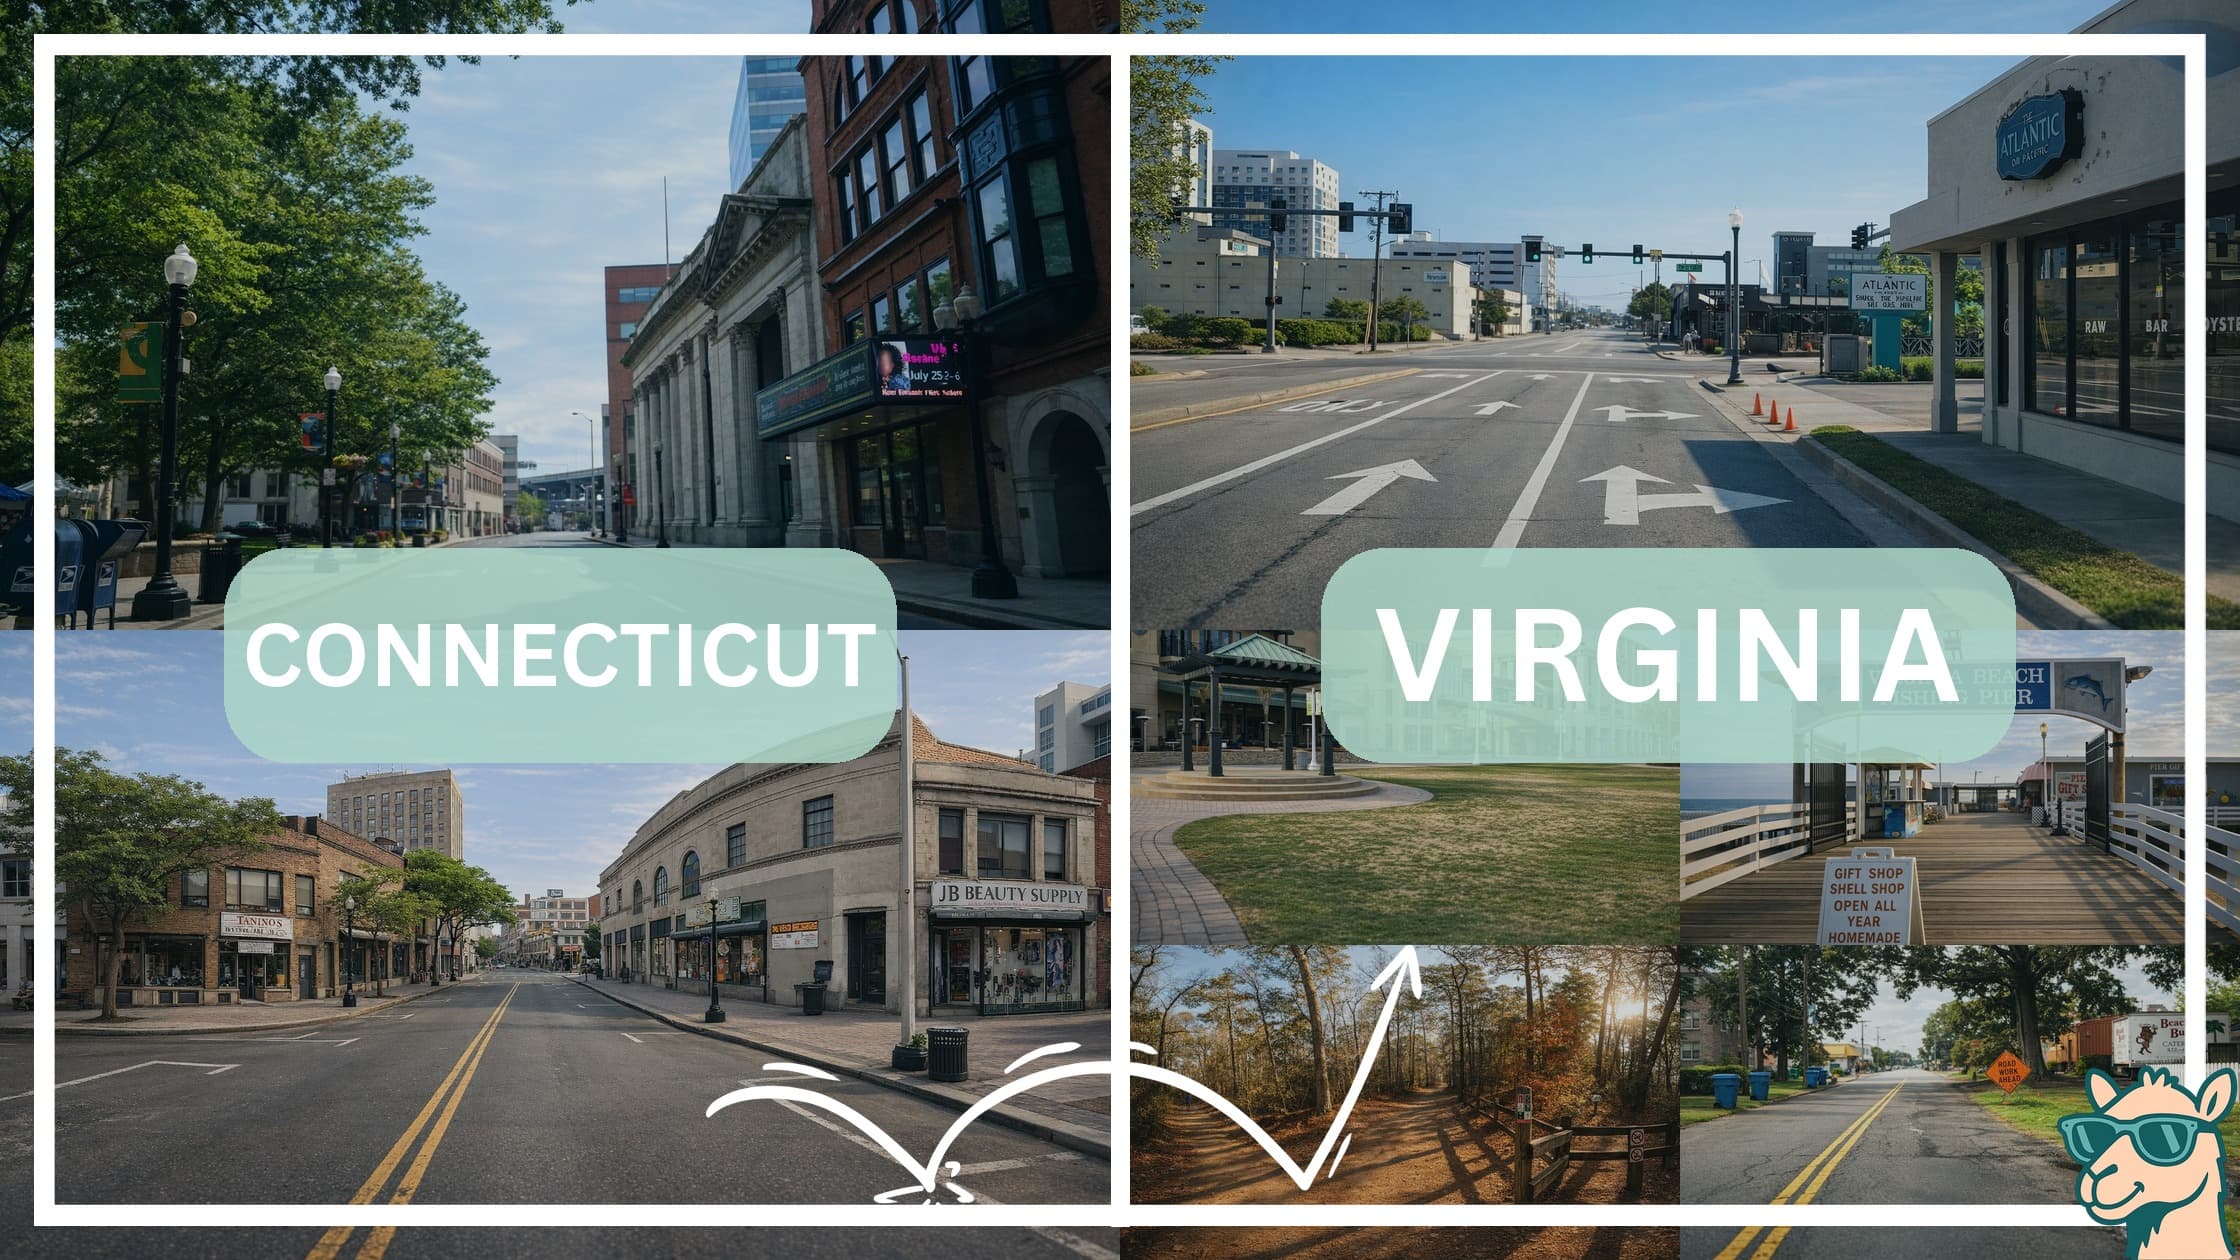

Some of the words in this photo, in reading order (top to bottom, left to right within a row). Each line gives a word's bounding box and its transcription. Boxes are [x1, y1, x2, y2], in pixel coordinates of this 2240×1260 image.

[2001, 112, 2060, 158] ATLANTIC
[1862, 280, 1916, 290] ATLANTIC
[2085, 321, 2107, 334] RAW
[2145, 319, 2168, 333] BAR
[910, 369, 929, 383] July
[1277, 398, 1401, 413] ONLY
[2058, 782, 2079, 794] GIFT
[1834, 868, 1862, 879] GIFT
[1868, 868, 1903, 879] SHOP
[939, 885, 959, 902] JB
[965, 886, 1027, 902] BEAUTY
[1031, 888, 1083, 904] SUPPLY
[1830, 883, 1867, 895] SHELL
[1871, 883, 1905, 895] SHOP
[1834, 900, 1868, 911] OPEN
[1874, 900, 1896, 911] ALL
[1847, 916, 1881, 927] YEAR
[1828, 932, 1901, 943] HOMEMADE
[1999, 1068, 2019, 1076] WORK
[1998, 1075, 2021, 1083] AHEAD
